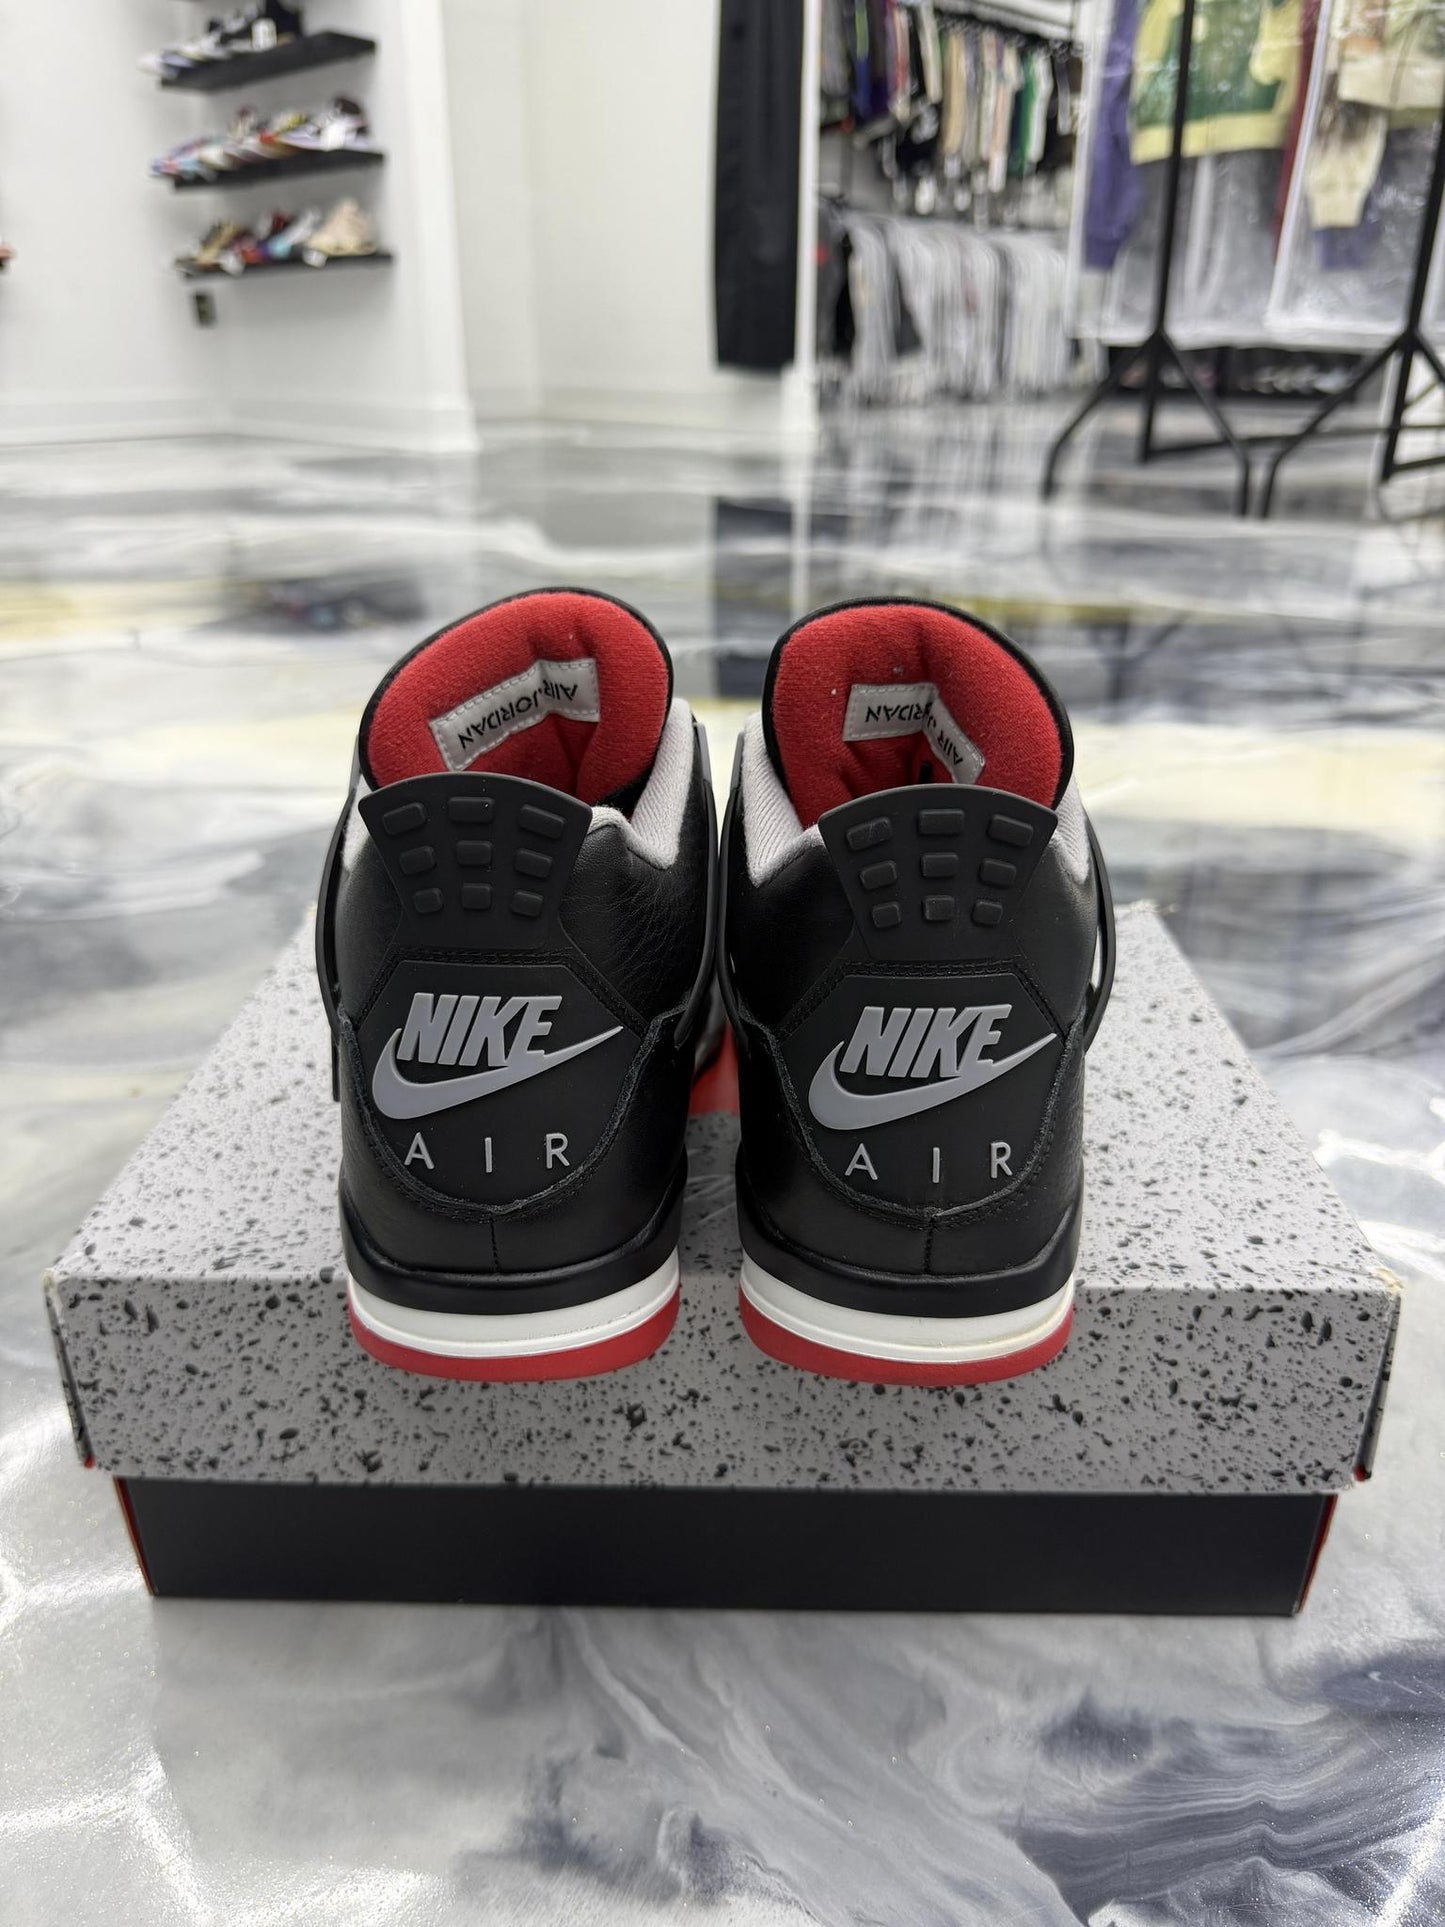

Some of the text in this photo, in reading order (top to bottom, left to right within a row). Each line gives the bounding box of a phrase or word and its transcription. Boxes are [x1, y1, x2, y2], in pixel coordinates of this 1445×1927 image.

[457, 680, 578, 749] AIR JORDAN
[937, 729, 963, 765] AIR
[396, 992, 562, 1067] NIKE
[839, 1003, 1012, 1078] NIKE
[404, 1132, 570, 1173] AIR
[844, 1142, 1013, 1184] AIR
